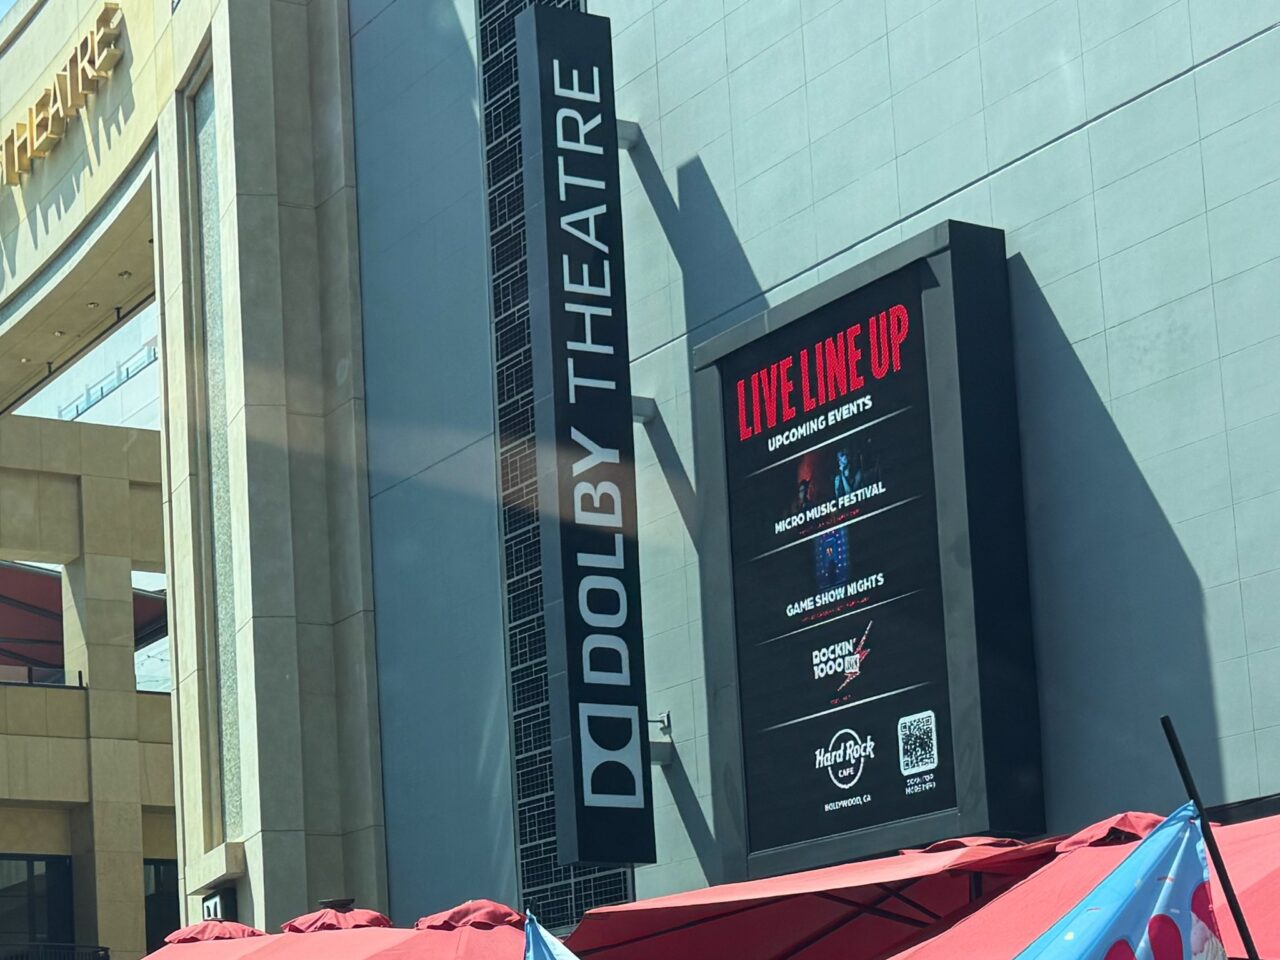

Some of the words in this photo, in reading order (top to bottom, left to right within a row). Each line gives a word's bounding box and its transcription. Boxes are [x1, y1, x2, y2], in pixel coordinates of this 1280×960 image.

[553, 59, 616, 404] THEATRE
[737, 356, 796, 441] LIVE
[800, 323, 865, 413] LINE
[869, 304, 908, 380] UP
[768, 415, 826, 451] UPCOMING
[828, 395, 873, 426] EVENTS
[774, 513, 805, 534] MICRO
[806, 500, 837, 521] MUSIC
[838, 481, 886, 509] FESTIVAL
[571, 427, 630, 686] DOLBY
[786, 597, 815, 617] GAME
[815, 586, 846, 607] SHOW
[847, 572, 884, 597] NIGHTS
[812, 638, 856, 665] ROCKIN'
[813, 658, 844, 679] 1000
[815, 742, 845, 768] Hard
[845, 735, 875, 764] Rock
[838, 766, 855, 778] CAFE
